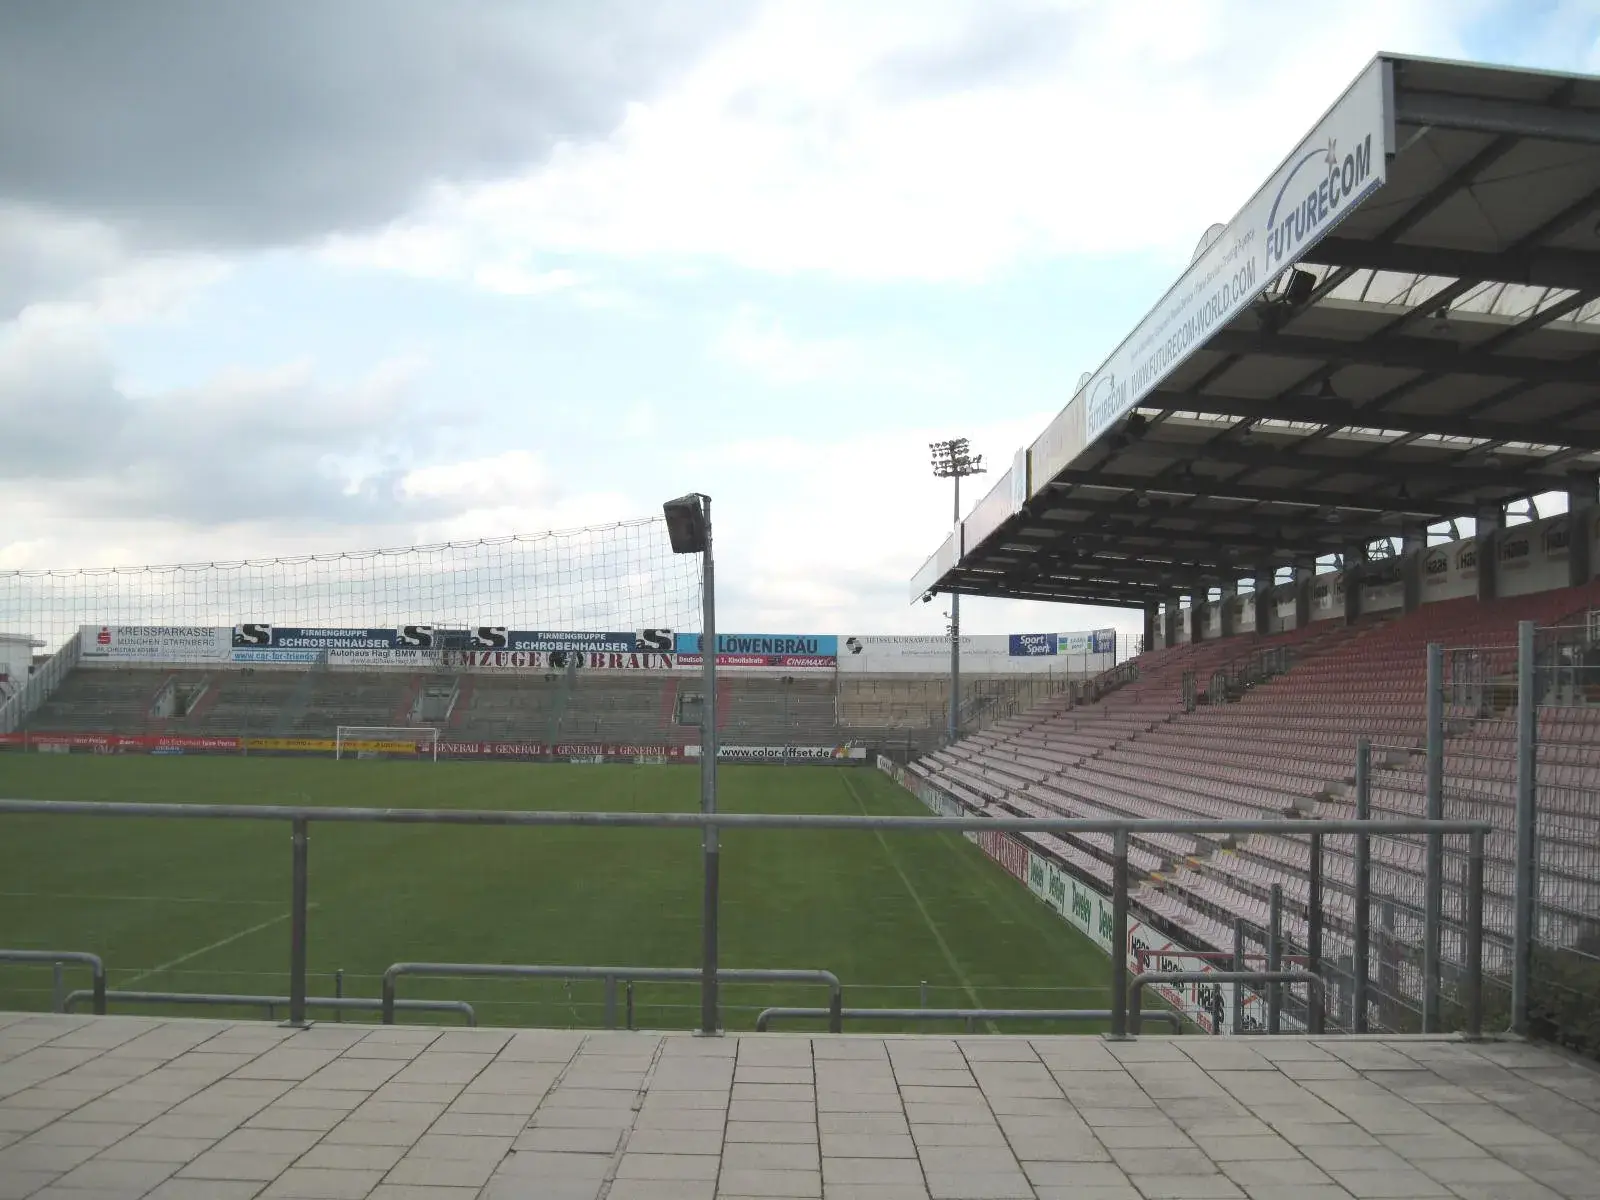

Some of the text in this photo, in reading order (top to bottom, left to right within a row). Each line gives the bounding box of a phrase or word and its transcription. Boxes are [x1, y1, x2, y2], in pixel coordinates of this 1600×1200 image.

[1265, 132, 1371, 272] FUTURECOM
[1088, 379, 1127, 436] FUTURECOM
[118, 626, 215, 637] KREISSPARKASSE
[538, 632, 606, 640] FIRMENGRUPPE
[163, 638, 215, 647] STARNBERG
[279, 639, 390, 648] SCHROBENHAUSER
[718, 635, 818, 654] LÖWENBRÄU
[1020, 635, 1044, 646] Sport
[515, 642, 628, 652] SCHROBENHAUSER
[330, 649, 370, 657] Autohaus
[590, 653, 674, 669] BRAUN
[495, 744, 540, 754] GENERALI
[558, 744, 603, 754] GENERALI
[620, 745, 665, 755] GENERALI
[721, 747, 830, 758] www.color-offset.de
[1099, 899, 1115, 942] Deve
